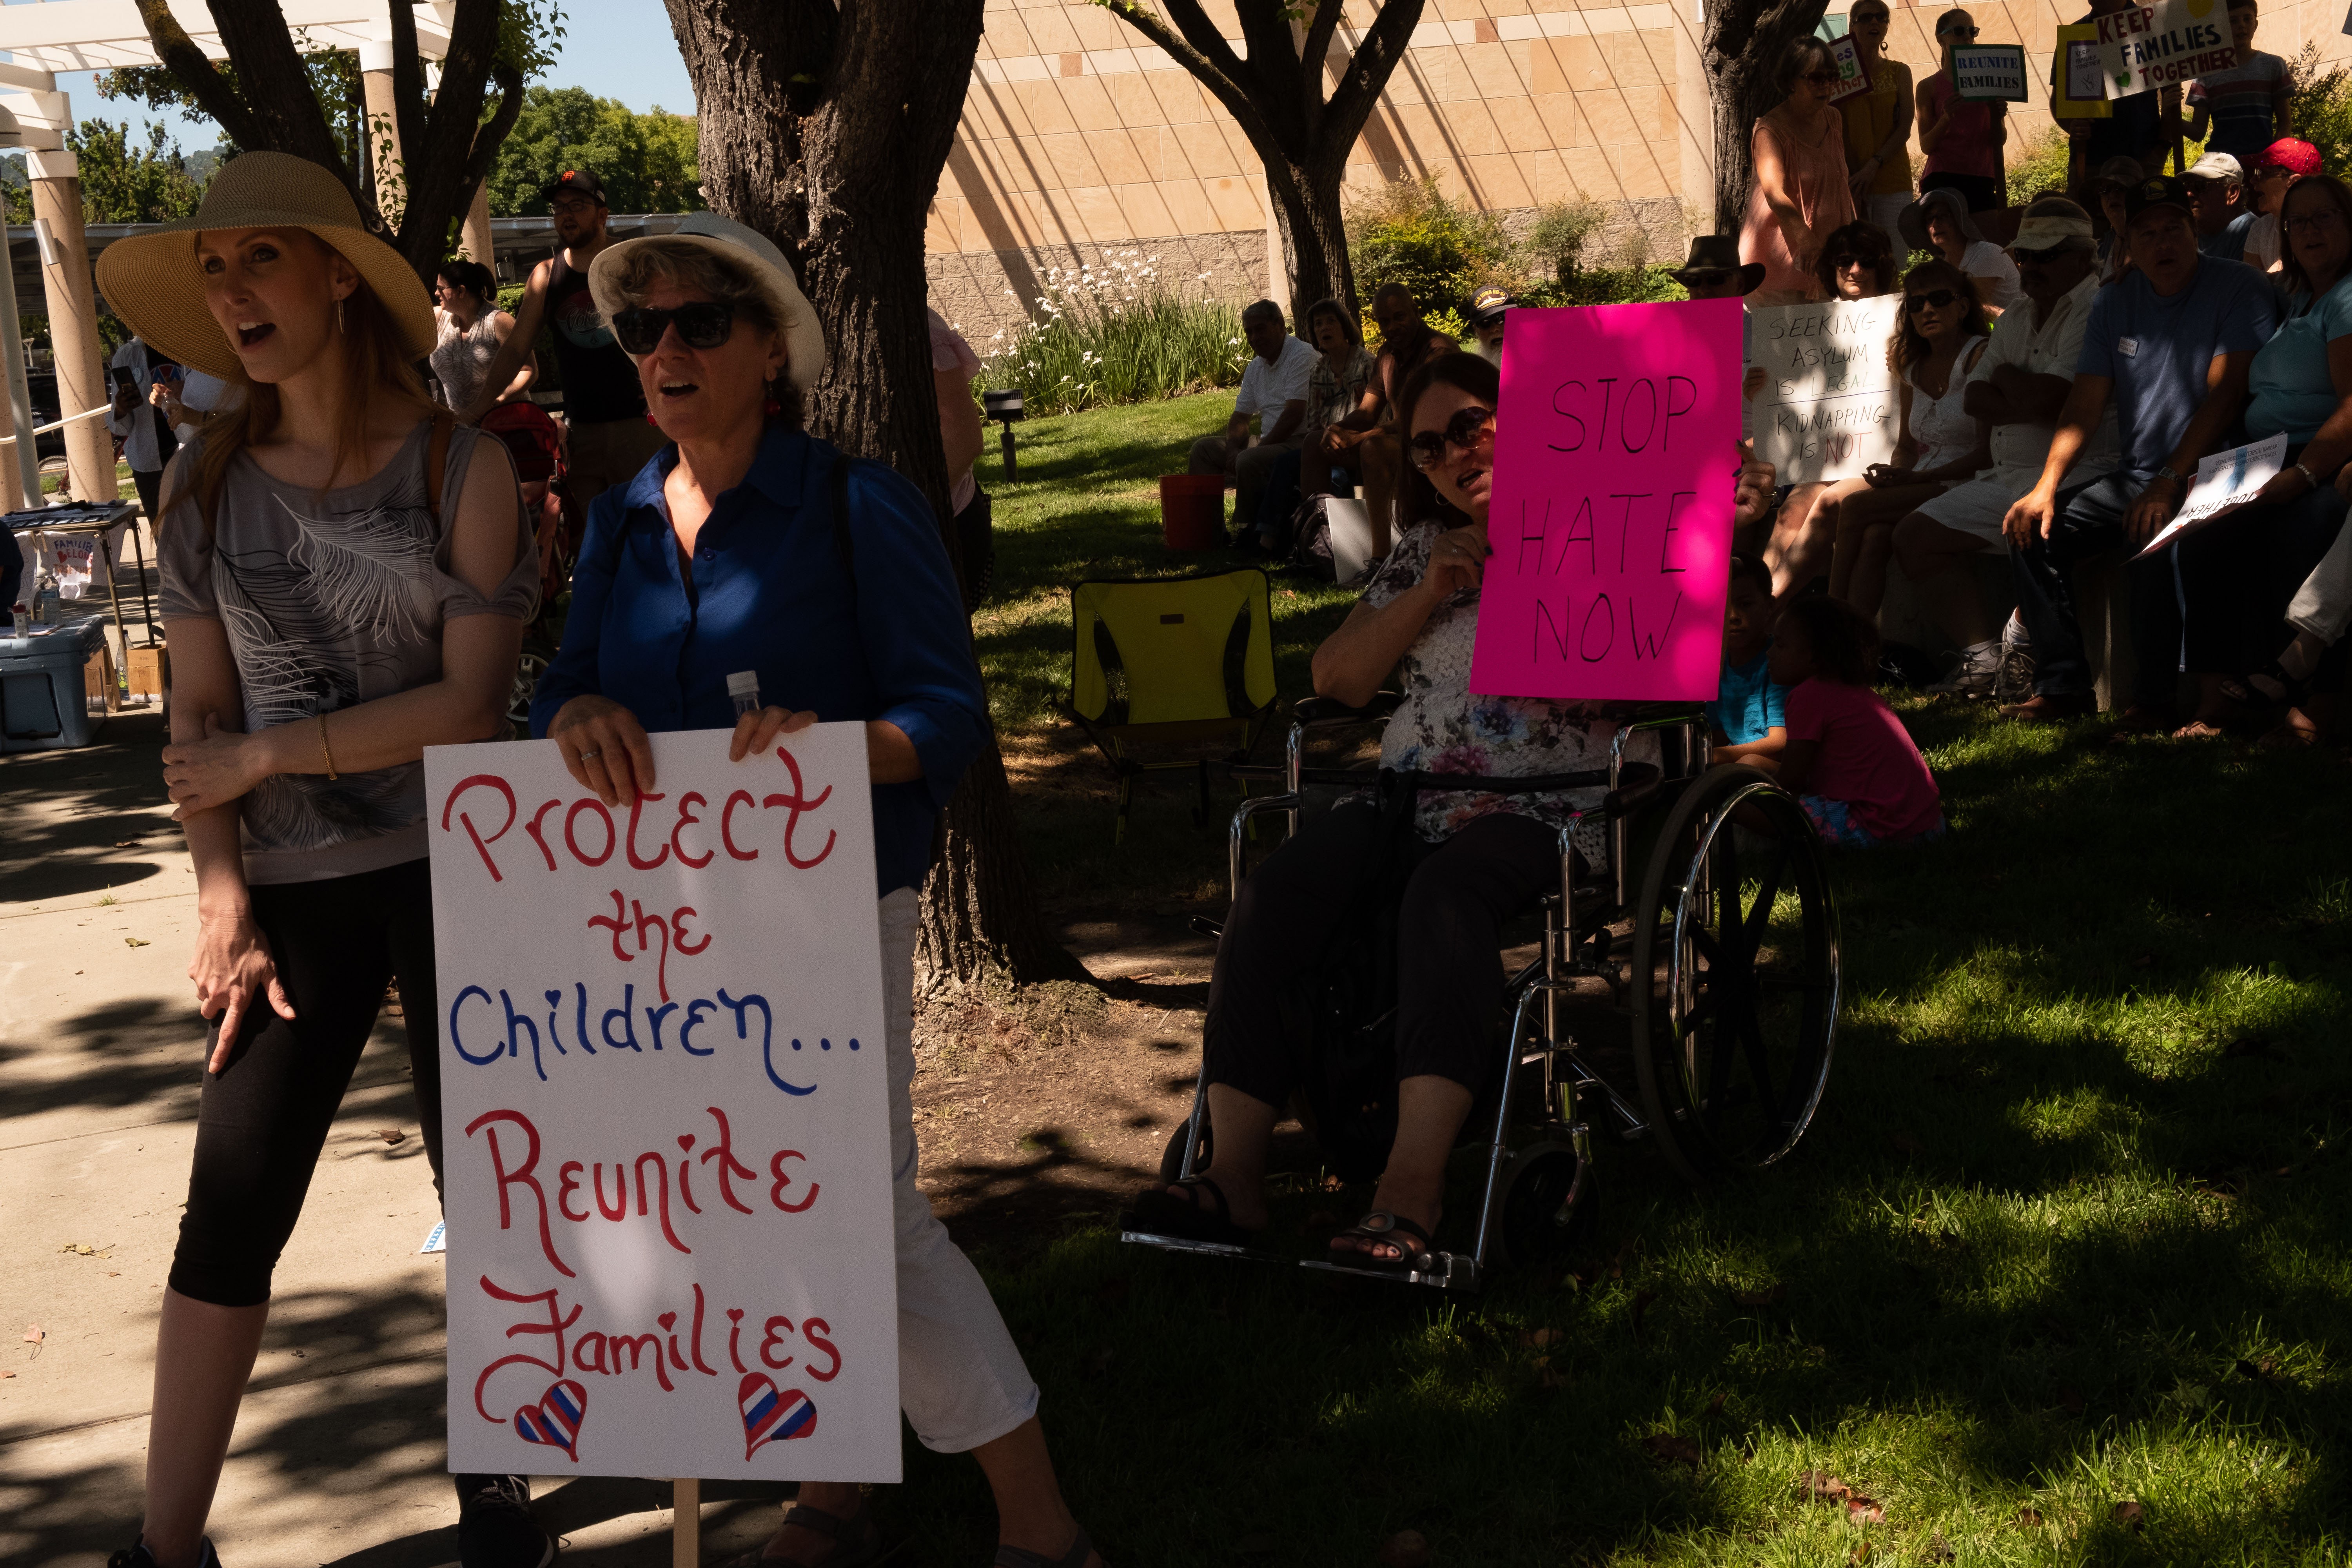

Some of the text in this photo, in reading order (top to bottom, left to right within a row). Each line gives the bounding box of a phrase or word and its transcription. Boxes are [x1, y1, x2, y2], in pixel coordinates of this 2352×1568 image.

[2097, 7, 2154, 44] KEEP
[2121, 24, 2221, 67] FAMILIES
[1957, 56, 2018, 70] REUNITE
[1960, 76, 2020, 89] FAMILIES
[2138, 47, 2237, 87] TOGETHER
[1770, 312, 1876, 339] SEEKING
[1792, 344, 1868, 367] ASYLUM
[1775, 372, 1874, 396] IS LEGAL
[1548, 375, 1697, 454] STOP
[1777, 405, 1891, 436] KIDNAPPING
[1800, 432, 1873, 463] IS NOT
[54, 540, 93, 553] FAMILIES
[1518, 492, 1697, 575] HATE
[1534, 590, 1682, 664] NOW
[442, 746, 837, 882] Protect
[588, 889, 712, 1004] the
[450, 982, 860, 1096] Children...
[465, 1107, 820, 1278] Reunite
[474, 1274, 842, 1424] Families
